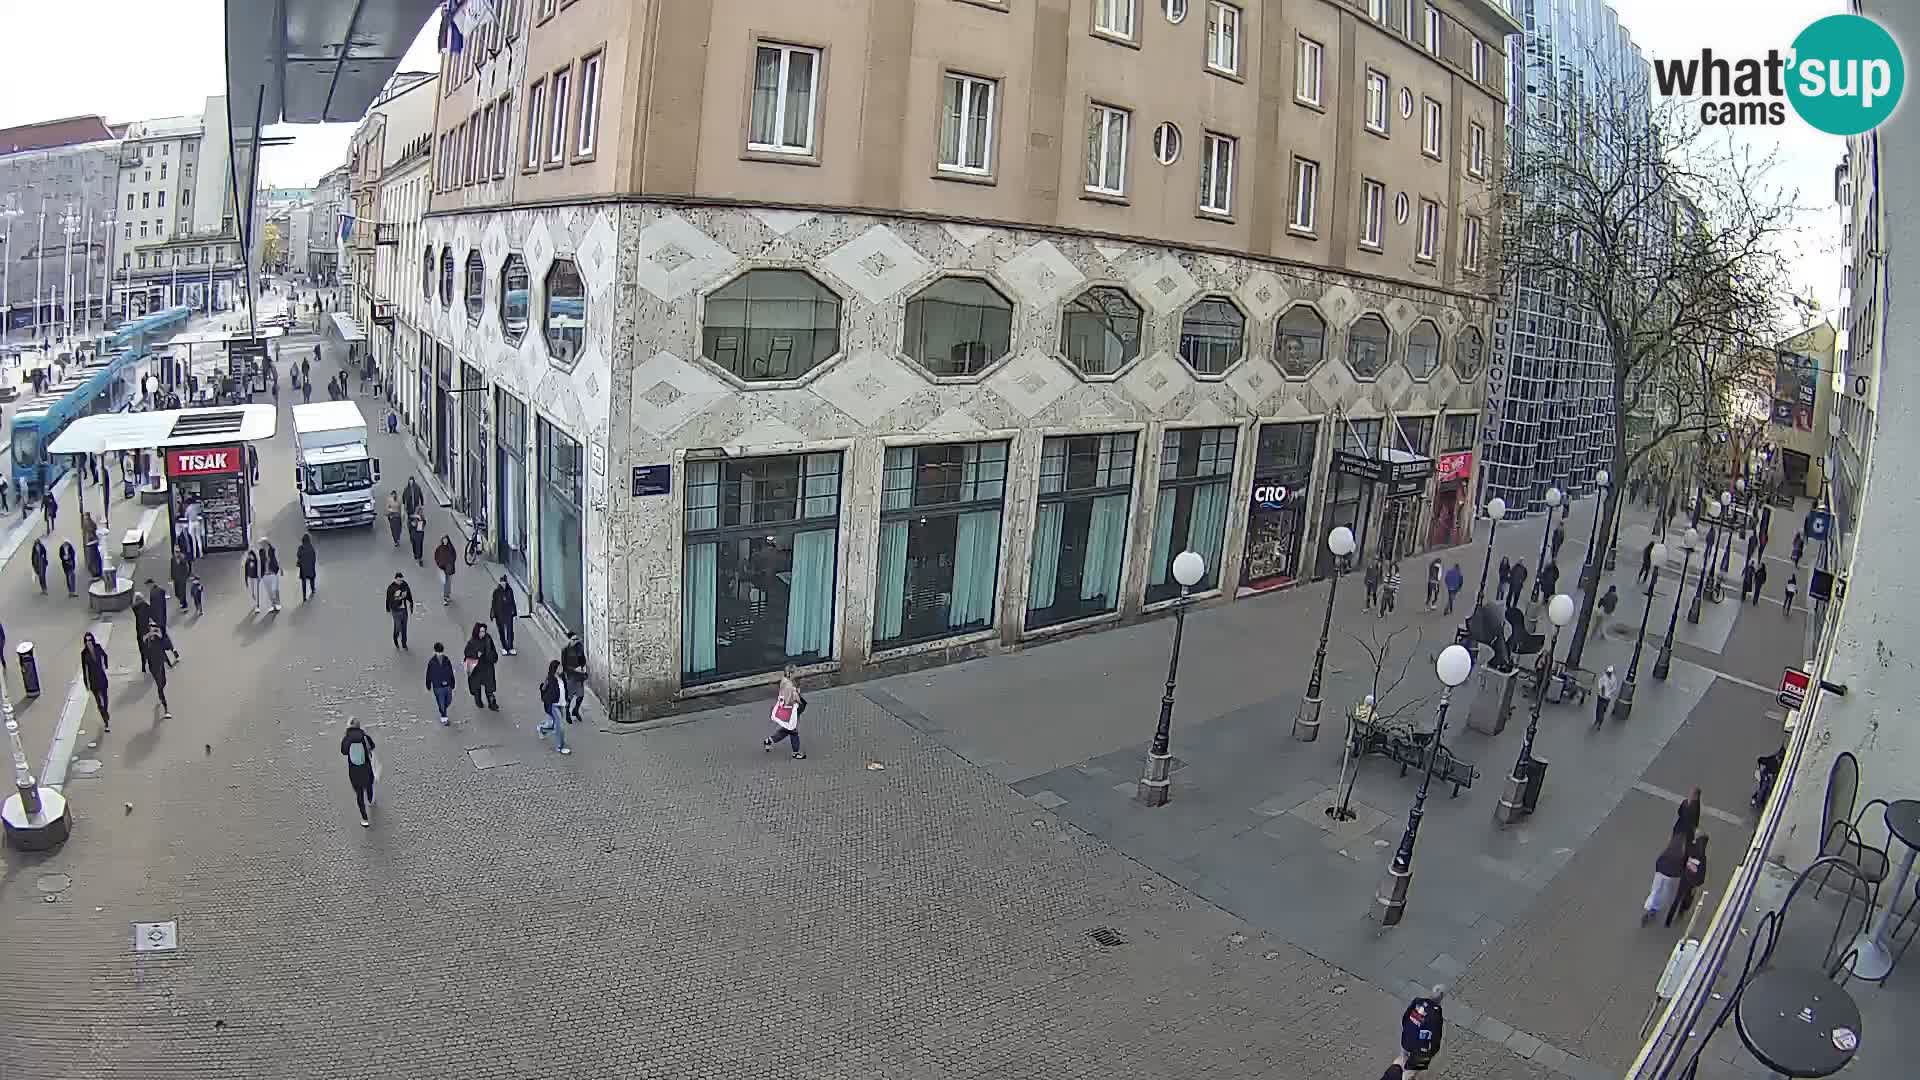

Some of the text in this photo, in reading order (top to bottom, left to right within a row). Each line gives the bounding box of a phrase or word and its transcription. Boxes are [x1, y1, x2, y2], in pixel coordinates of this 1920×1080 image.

[1483, 306, 1509, 441] DUBROVNIK
[179, 453, 228, 471] TISAK
[1255, 486, 1286, 502] CRO
